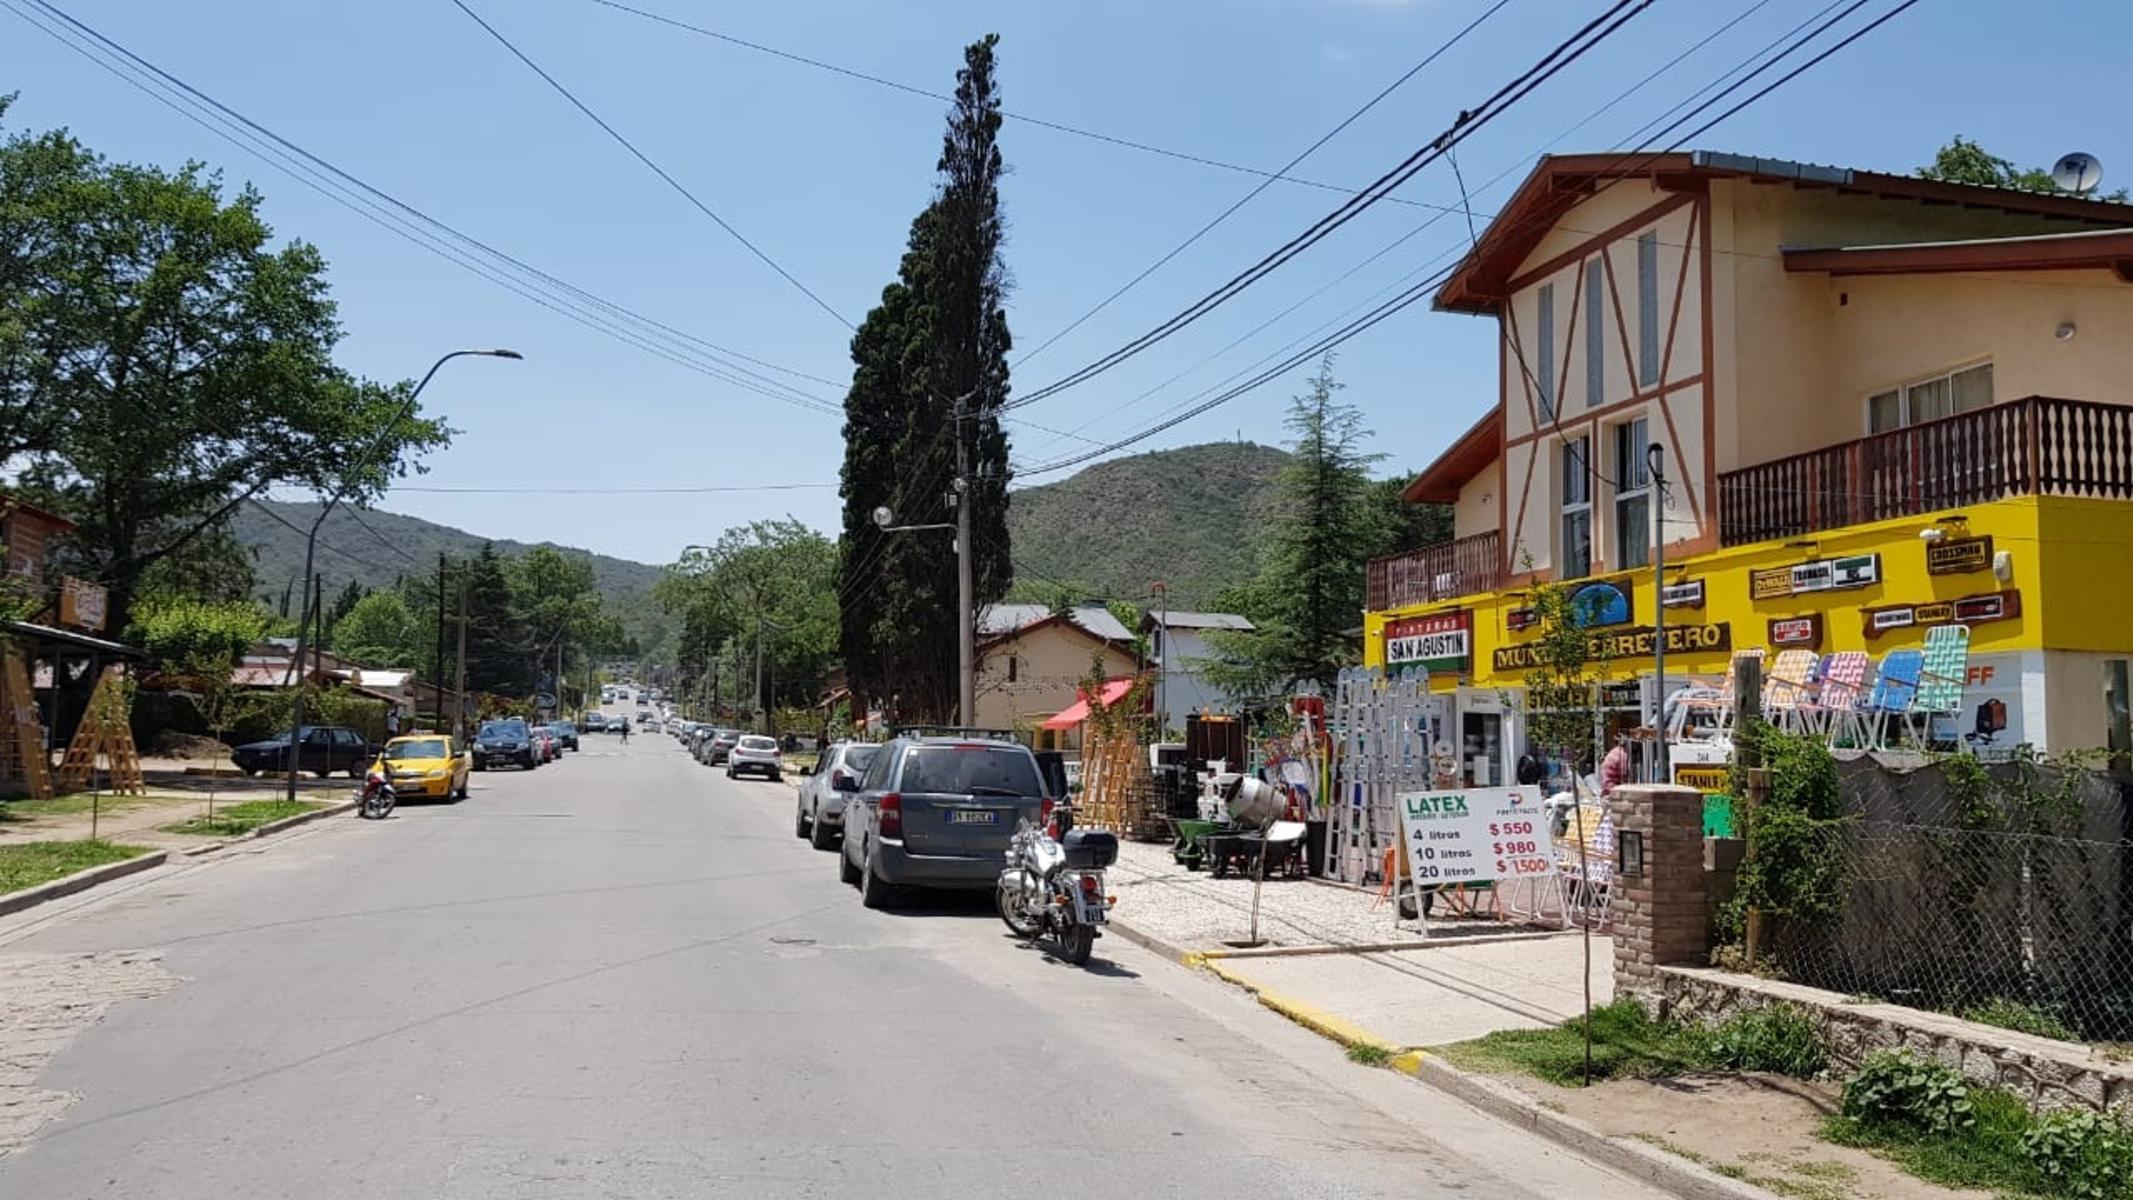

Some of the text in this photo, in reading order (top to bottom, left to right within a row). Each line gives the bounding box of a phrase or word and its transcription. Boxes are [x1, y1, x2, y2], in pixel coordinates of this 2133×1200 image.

[1391, 633, 1464, 660] SAN AGUSTIN
[1407, 795, 1468, 814] LATEX
[1413, 821, 1533, 840] 4 litros $ 550
[1415, 841, 1536, 860] 10 litros $ 980
[1419, 865, 1439, 878] 20
[1444, 867, 1476, 877] litros
[1496, 860, 1507, 873] $
